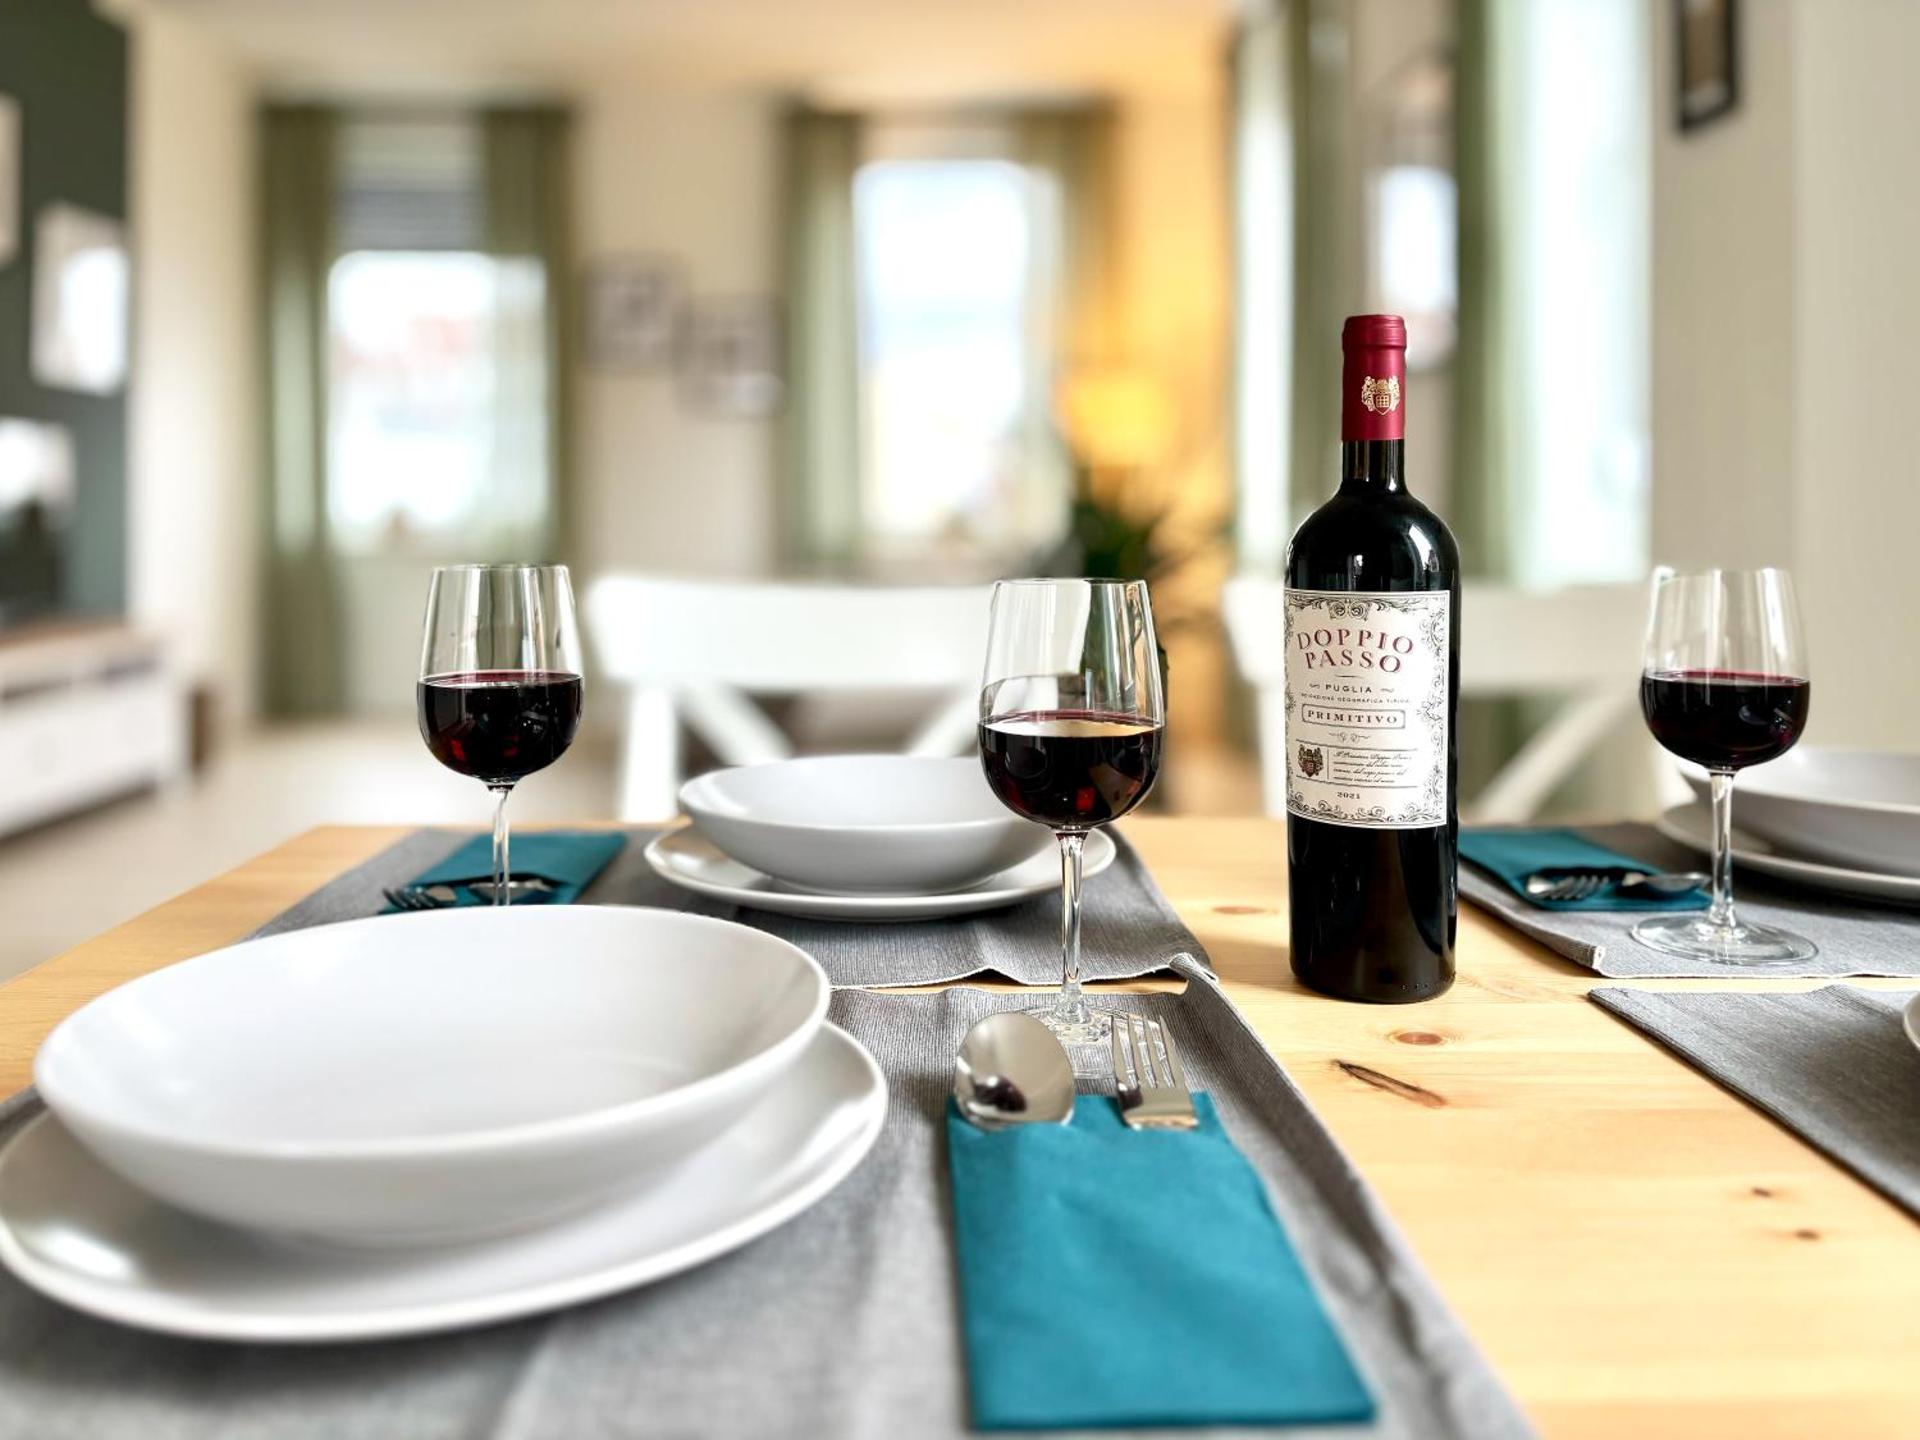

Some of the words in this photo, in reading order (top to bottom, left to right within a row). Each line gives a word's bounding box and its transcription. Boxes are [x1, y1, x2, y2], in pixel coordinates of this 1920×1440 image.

[1297, 629, 1413, 654] DOPPIO
[1305, 649, 1401, 673] PASSO
[1325, 684, 1372, 693] PUGLIA
[1307, 710, 1397, 723] PRIMITIVO
[1337, 791, 1360, 799] 2021
